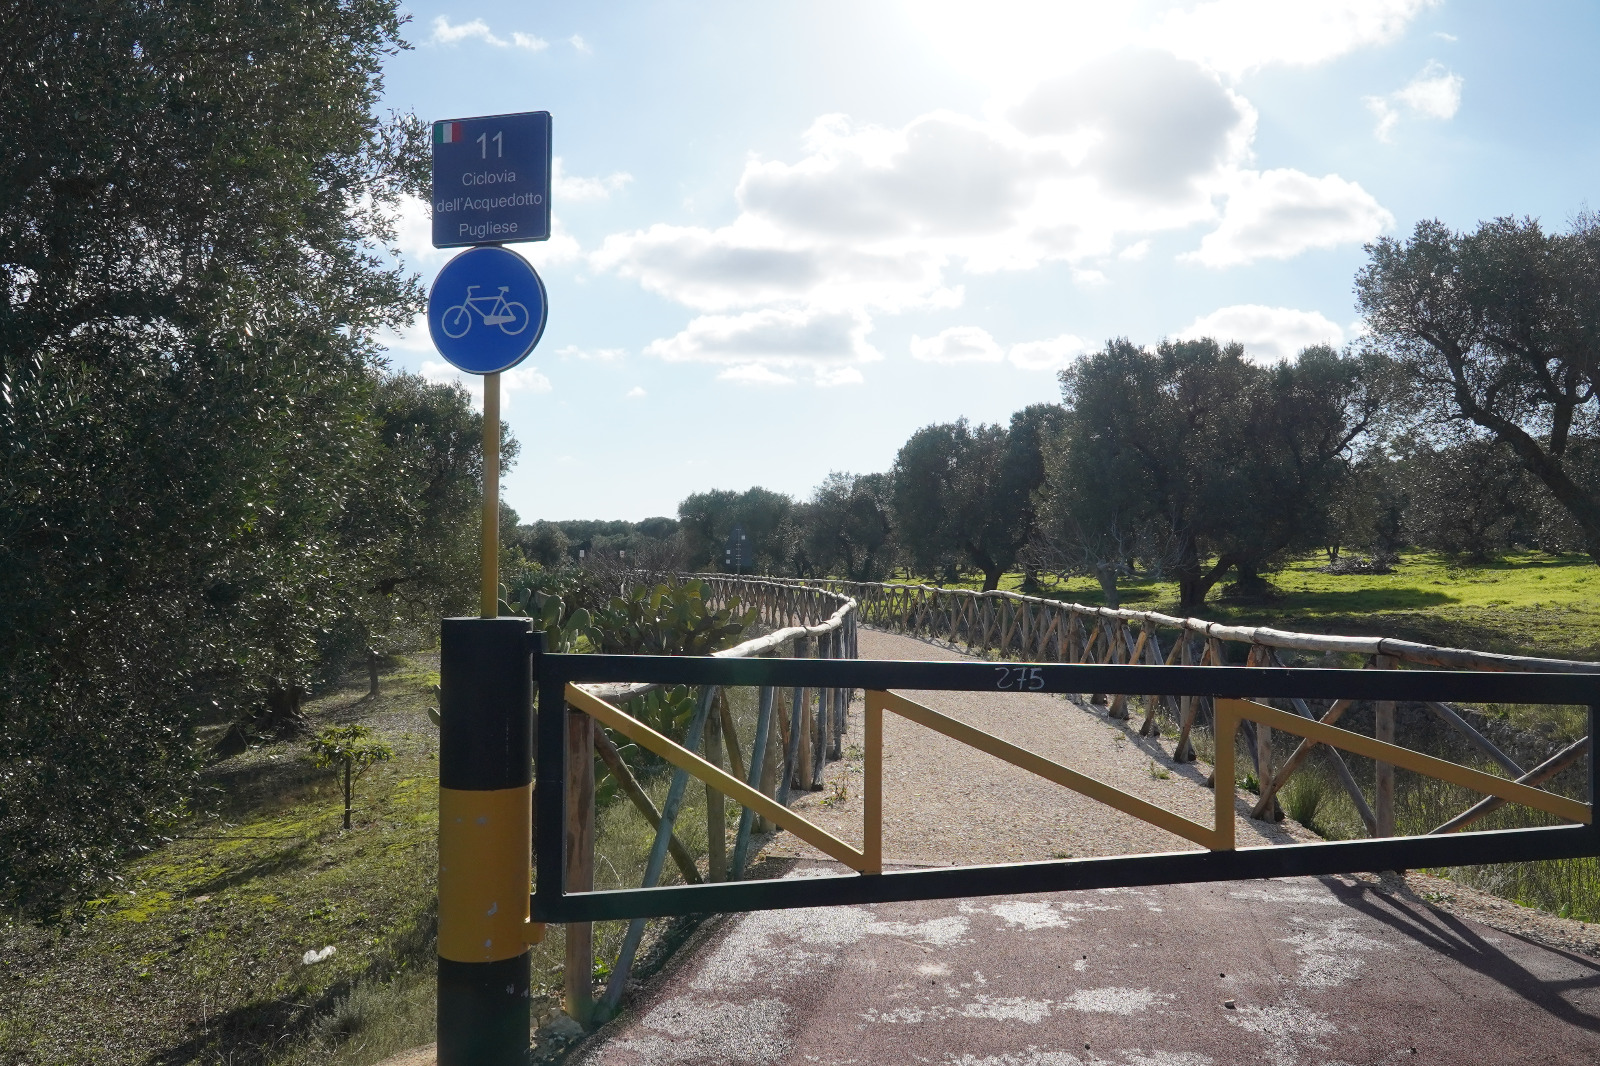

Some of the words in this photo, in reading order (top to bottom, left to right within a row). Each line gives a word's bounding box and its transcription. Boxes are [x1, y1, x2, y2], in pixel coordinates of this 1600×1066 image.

[476, 131, 502, 159] 11
[462, 170, 516, 186] Ciclovia
[436, 192, 543, 213] dell'Acquedotto
[459, 221, 518, 239] Pugliese
[995, 666, 1045, 690] 275
